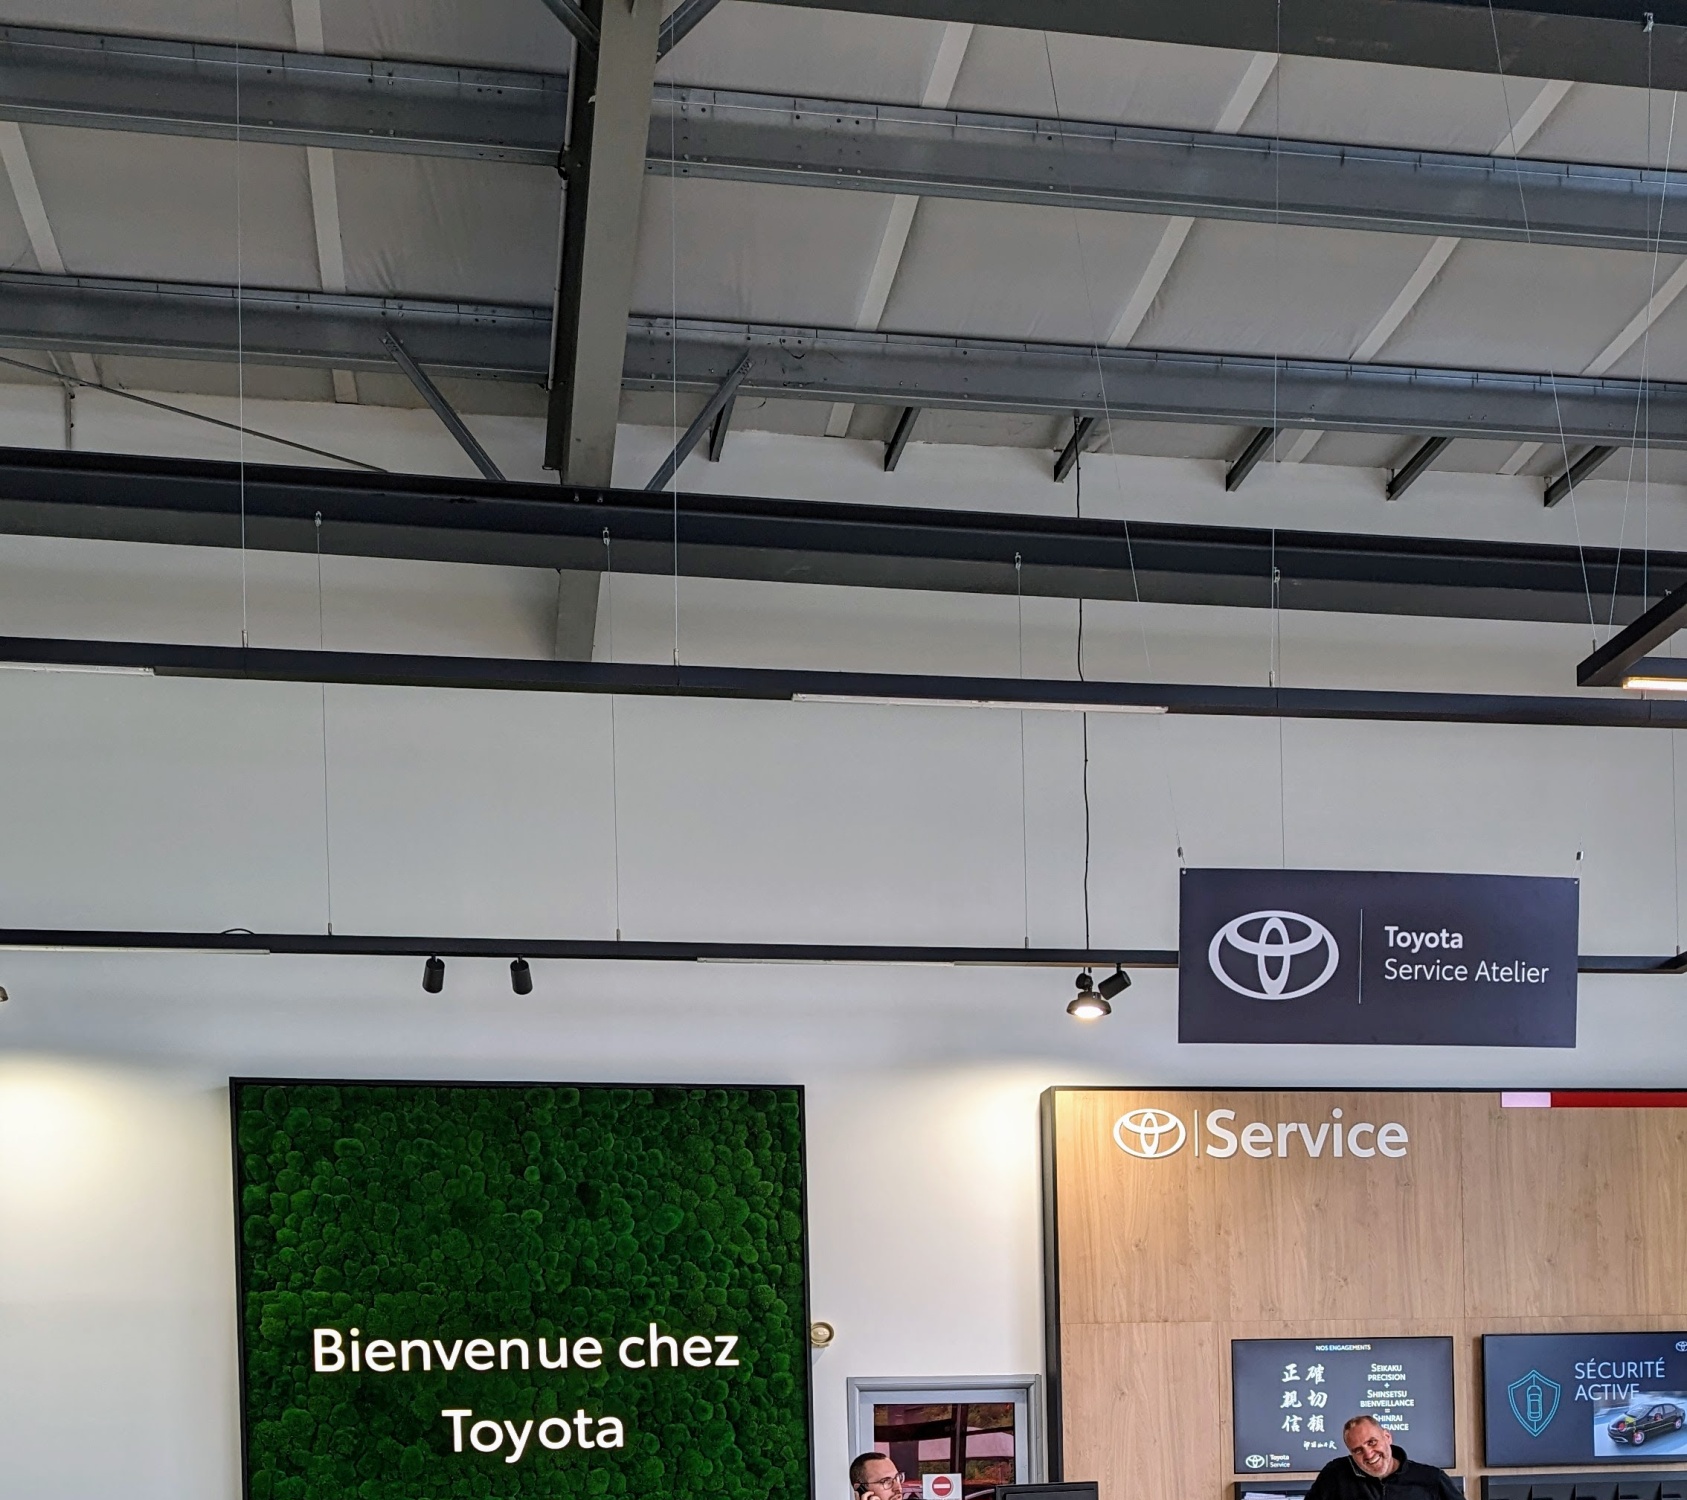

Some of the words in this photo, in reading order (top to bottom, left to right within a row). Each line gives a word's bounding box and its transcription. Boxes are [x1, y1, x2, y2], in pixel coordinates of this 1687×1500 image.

[1384, 925, 1464, 954] Toyota
[1384, 958, 1468, 982] Service
[1474, 960, 1550, 984] Atelier
[1205, 1107, 1409, 1158] Service
[312, 1327, 603, 1373] Bienvenue
[618, 1322, 740, 1369] chez
[1574, 1357, 1666, 1379] SÉCURITÉ
[1574, 1383, 1640, 1401] ACTIVE
[441, 1409, 624, 1464] Toyota
[1269, 1454, 1290, 1462] Toyota
